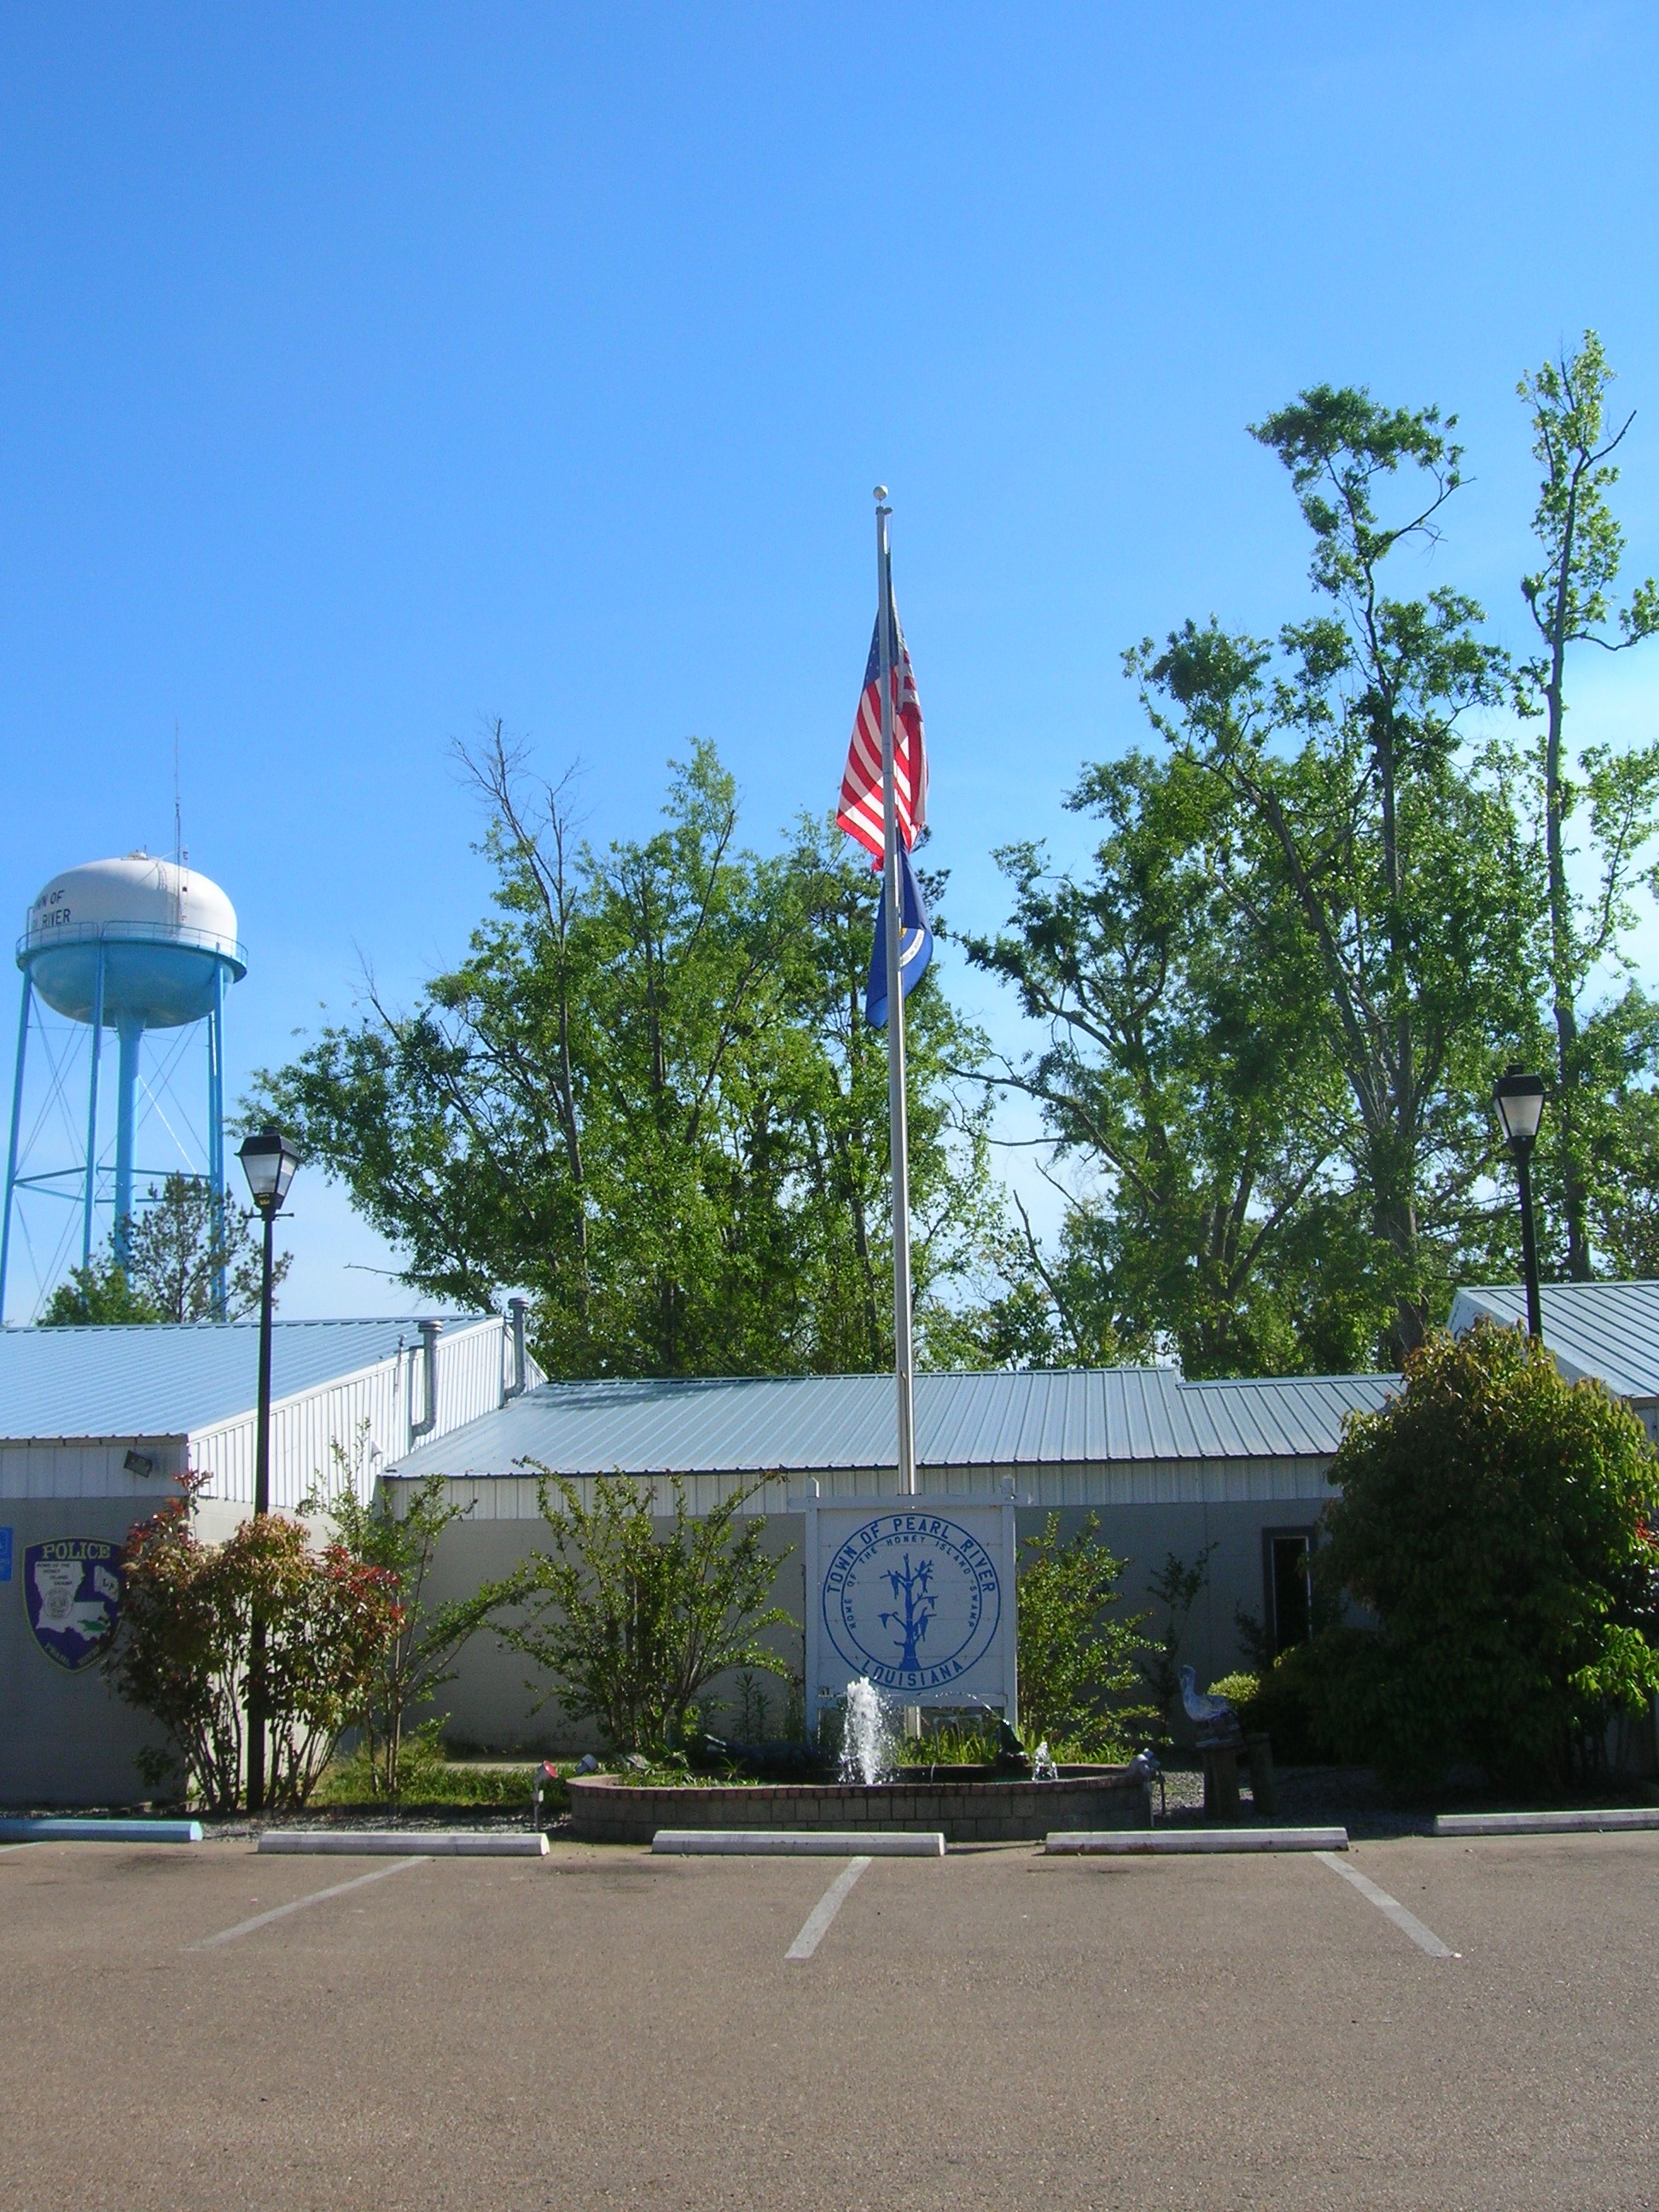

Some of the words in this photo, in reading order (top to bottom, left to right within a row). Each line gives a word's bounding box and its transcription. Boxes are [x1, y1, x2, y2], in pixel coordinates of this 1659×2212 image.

[49, 889, 66, 905] OF
[42, 908, 72, 928] RIVER
[886, 1534, 927, 1546] HONEY
[42, 1541, 110, 1560] POLICE
[826, 1545, 858, 1593] TOWN
[860, 1521, 881, 1544] OF
[893, 1516, 950, 1540] PEARL
[959, 1540, 997, 1592] RIVER
[859, 1545, 878, 1565] THE
[934, 1540, 971, 1575] ISLAND
[847, 1574, 857, 1587] OF
[844, 1598, 857, 1629] HOME
[860, 1659, 964, 1687] LOUISIANA
